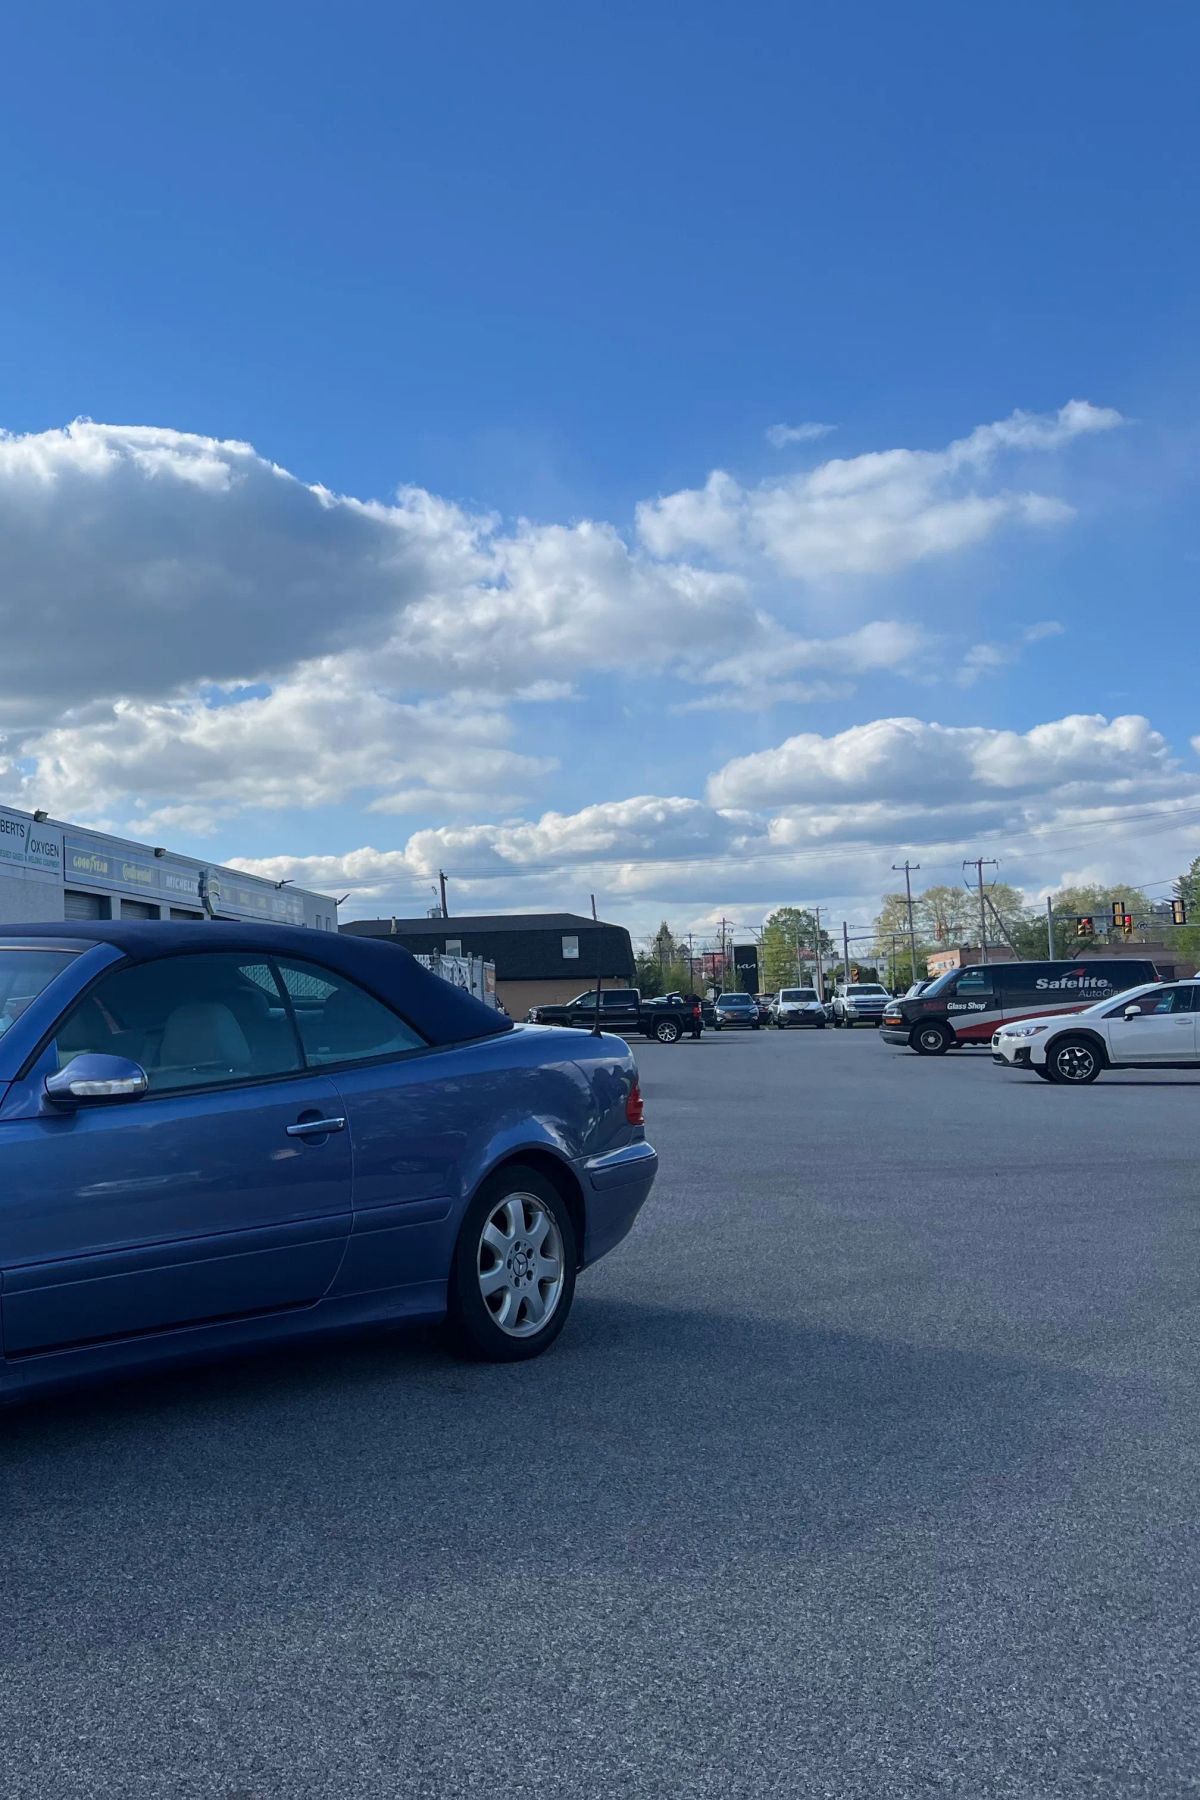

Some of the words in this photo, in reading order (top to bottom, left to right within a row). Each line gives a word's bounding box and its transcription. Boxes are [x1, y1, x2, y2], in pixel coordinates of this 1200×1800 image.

[30, 839, 60, 858] OXYGEN
[1035, 977, 1108, 989] Safelite
[947, 1002, 967, 1010] Glass
[967, 1002, 986, 1011] Shop
